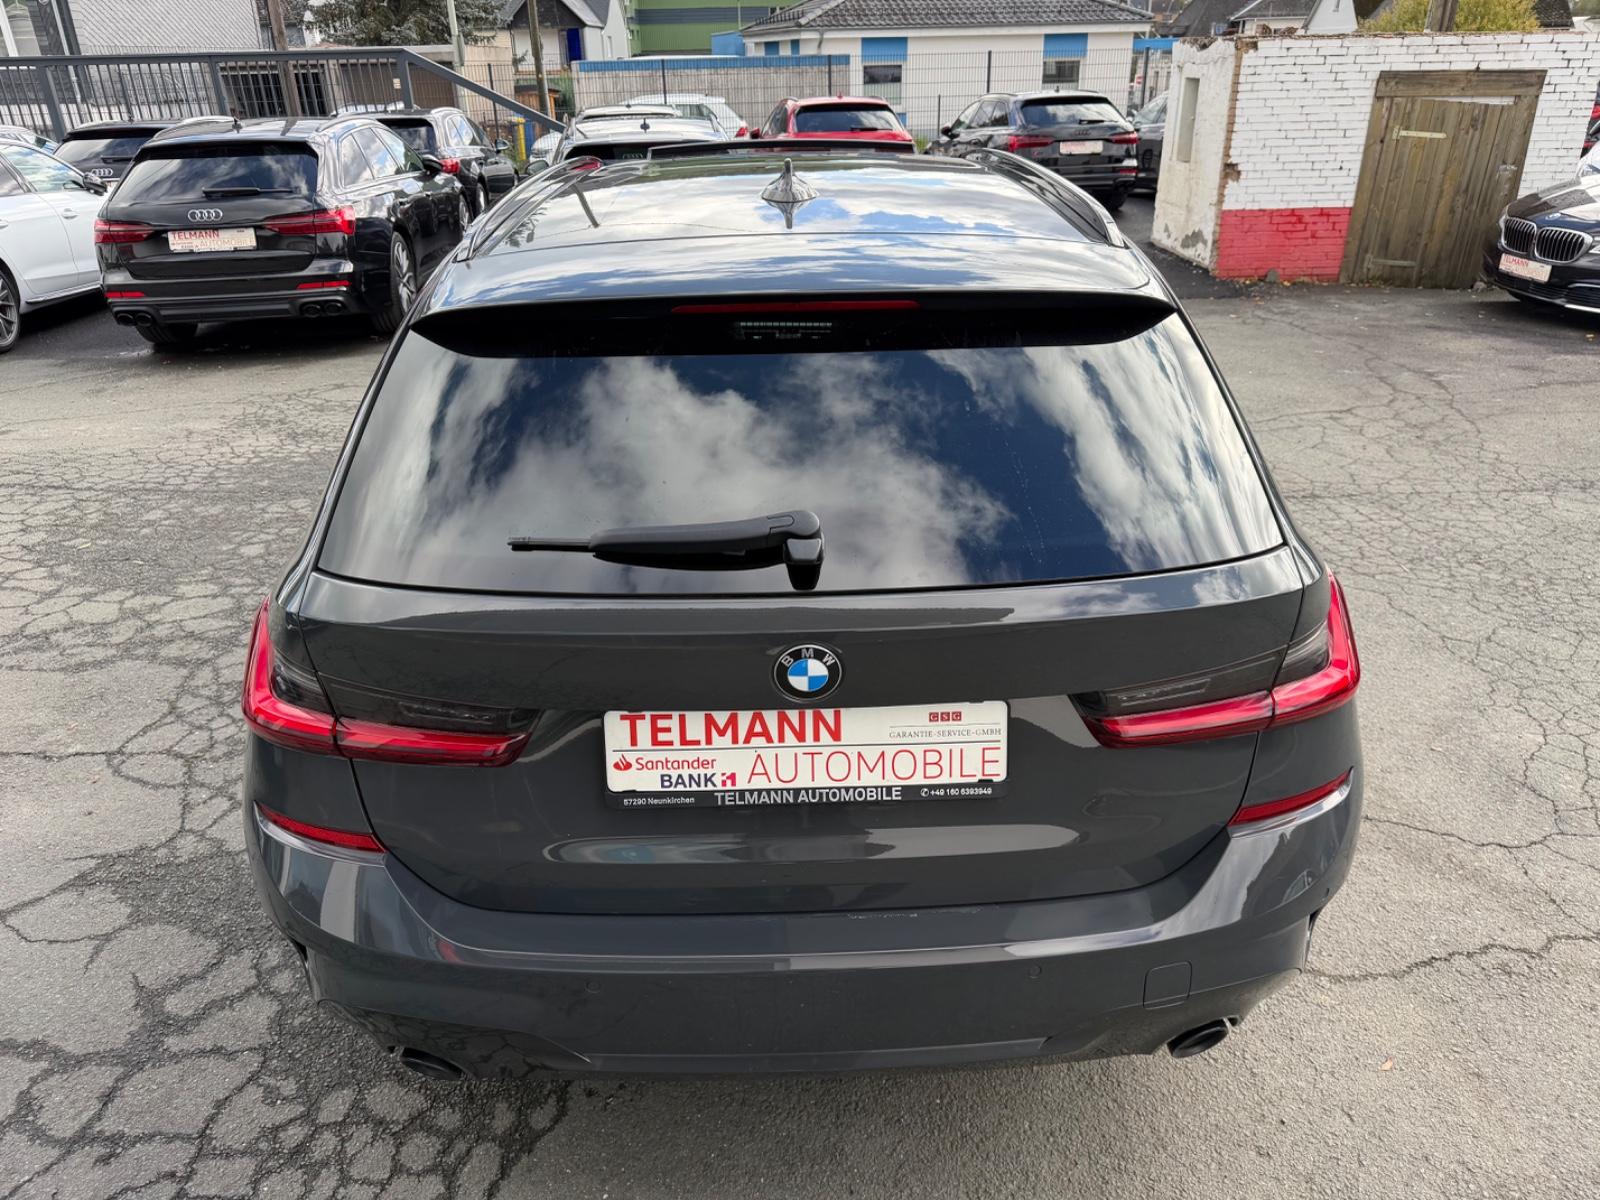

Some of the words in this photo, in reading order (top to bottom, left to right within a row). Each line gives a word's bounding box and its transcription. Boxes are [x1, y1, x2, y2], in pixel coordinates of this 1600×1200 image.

[171, 229, 220, 240] TELMANN
[781, 648, 836, 667] BMW
[930, 712, 961, 721] GSG
[620, 709, 842, 747] TELMANN
[635, 756, 717, 771] Santander
[748, 747, 1002, 784] AUTOMOBILE
[660, 773, 717, 788] BANK
[648, 797, 695, 805] Neunkirchen
[714, 791, 794, 806] TELMANN
[797, 787, 902, 803] AUTOMOBILE
